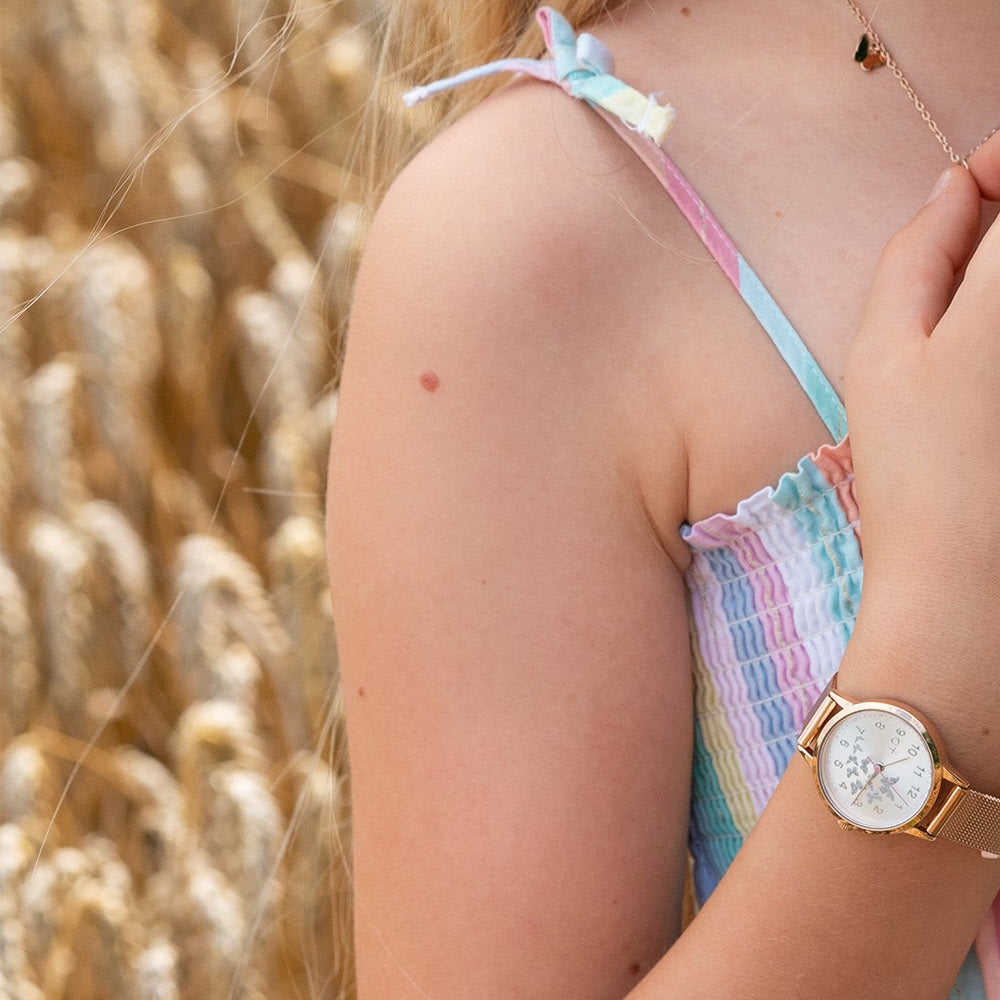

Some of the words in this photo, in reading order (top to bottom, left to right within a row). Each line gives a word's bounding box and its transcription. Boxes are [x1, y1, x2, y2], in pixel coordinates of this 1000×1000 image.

[856, 726, 865, 734] 7
[875, 722, 886, 730] 8
[896, 728, 906, 737] 9
[840, 739, 849, 748] 6
[908, 744, 920, 757] 10
[834, 760, 843, 768] 5
[913, 766, 925, 778] 11
[838, 782, 847, 790] 4
[907, 786, 920, 799] 12
[873, 805, 884, 814] 2
